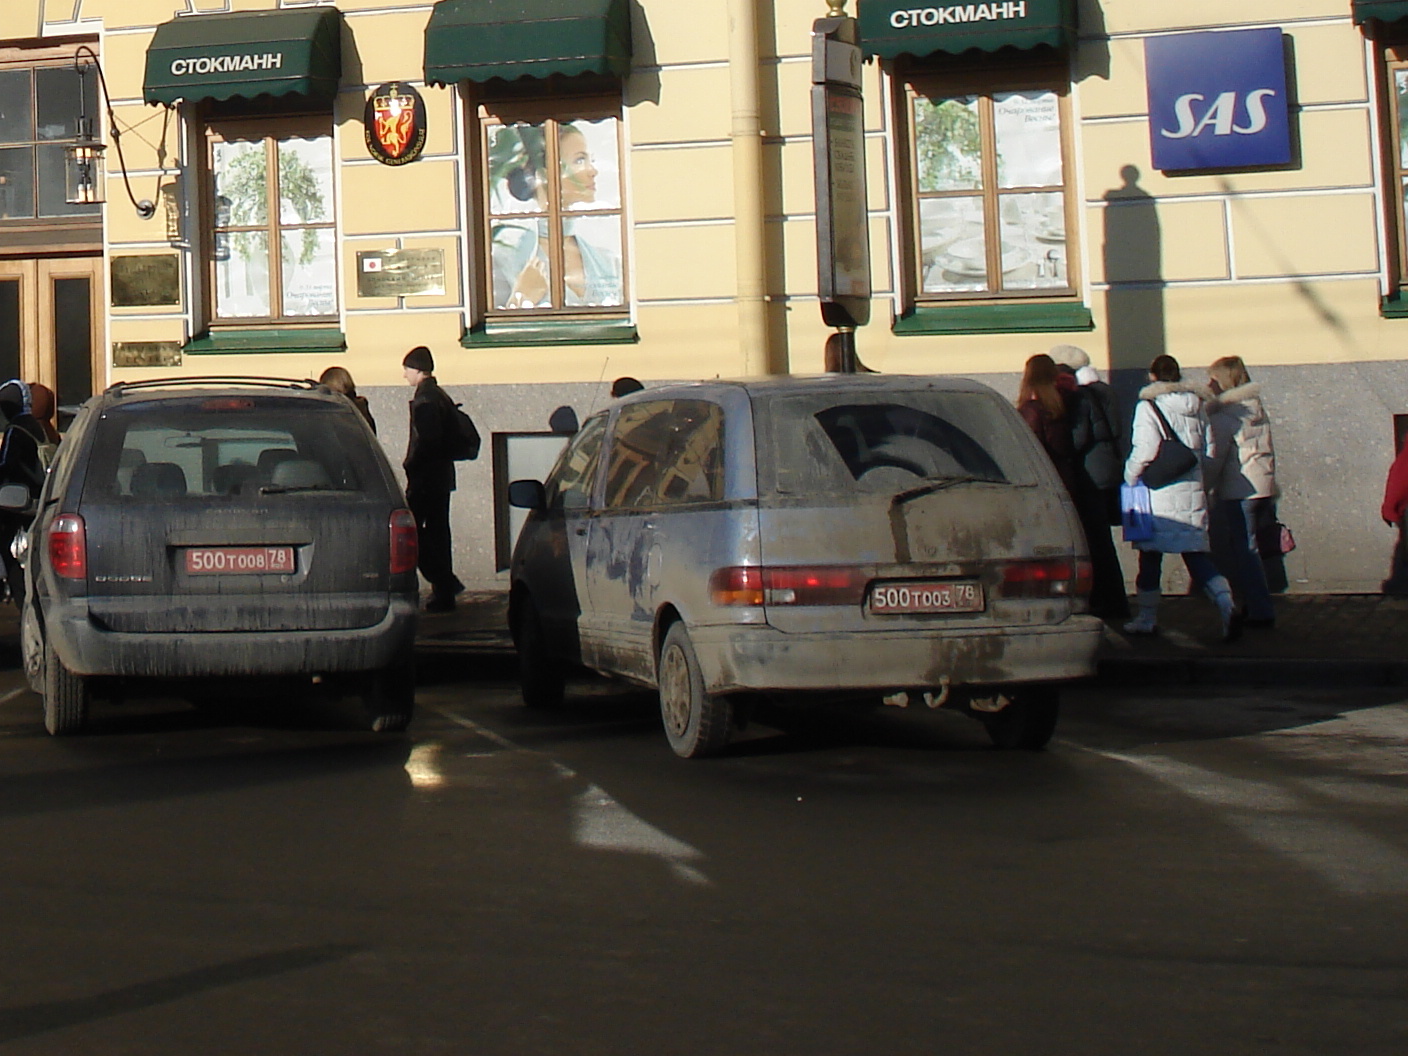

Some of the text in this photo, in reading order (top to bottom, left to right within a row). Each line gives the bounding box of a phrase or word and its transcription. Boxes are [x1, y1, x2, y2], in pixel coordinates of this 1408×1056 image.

[890, 0, 1027, 29] СТОКМАНН
[170, 52, 283, 76] СТОКМАНН
[1159, 87, 1276, 139] SAS
[268, 549, 286, 563] 78
